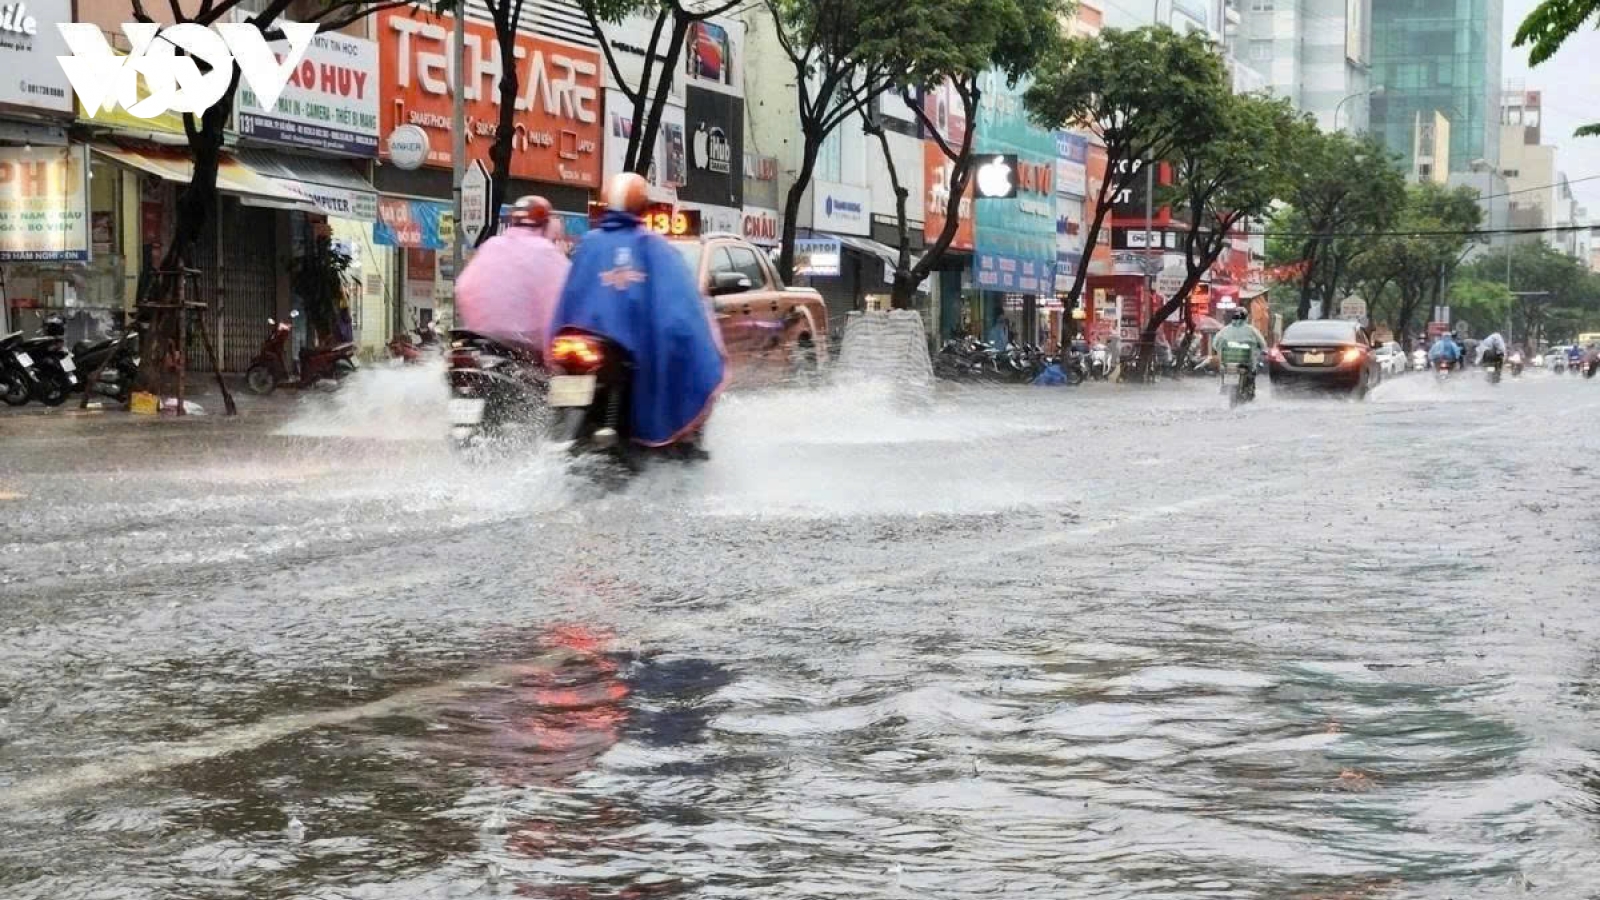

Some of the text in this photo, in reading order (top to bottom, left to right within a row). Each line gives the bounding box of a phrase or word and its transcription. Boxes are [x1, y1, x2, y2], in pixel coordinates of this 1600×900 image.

[0, 3, 36, 35] ile
[320, 63, 367, 100] HUY
[240, 114, 255, 135] 131
[391, 142, 421, 151] ANKER
[800, 243, 837, 252] LAPTOP
